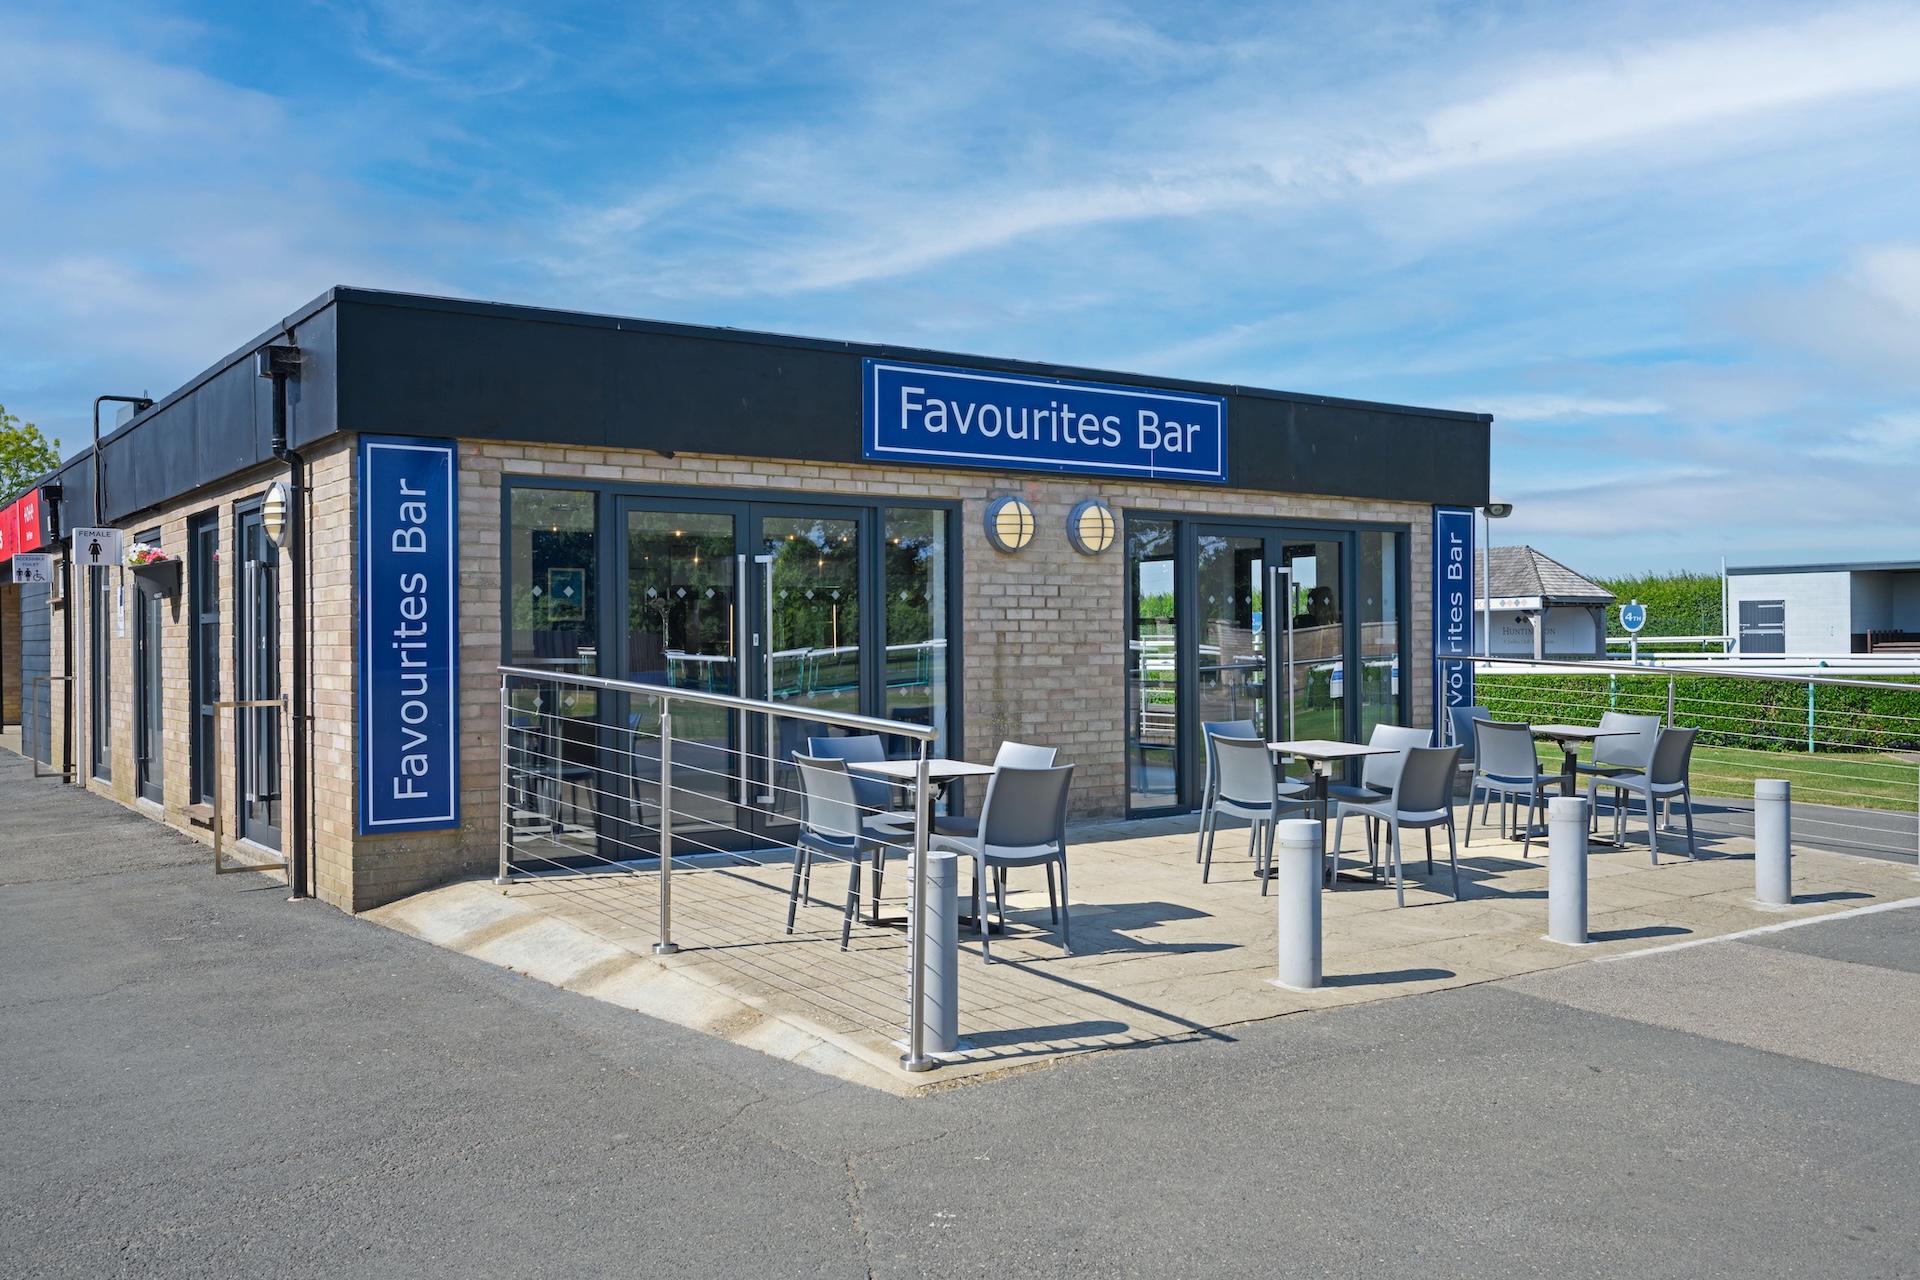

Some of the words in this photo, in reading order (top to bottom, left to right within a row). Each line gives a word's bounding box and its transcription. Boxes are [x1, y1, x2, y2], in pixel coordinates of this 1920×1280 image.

[901, 385, 1122, 448] Favourites
[1138, 409, 1200, 453] Bar
[78, 530, 112, 538] FEMALE
[392, 478, 427, 553] Bar
[1447, 532, 1463, 580] Bar
[1502, 626, 1556, 636] HUNTINON
[1625, 612, 1642, 622] 4TH
[1447, 592, 1464, 706] vourites
[392, 572, 429, 800] Favourites
